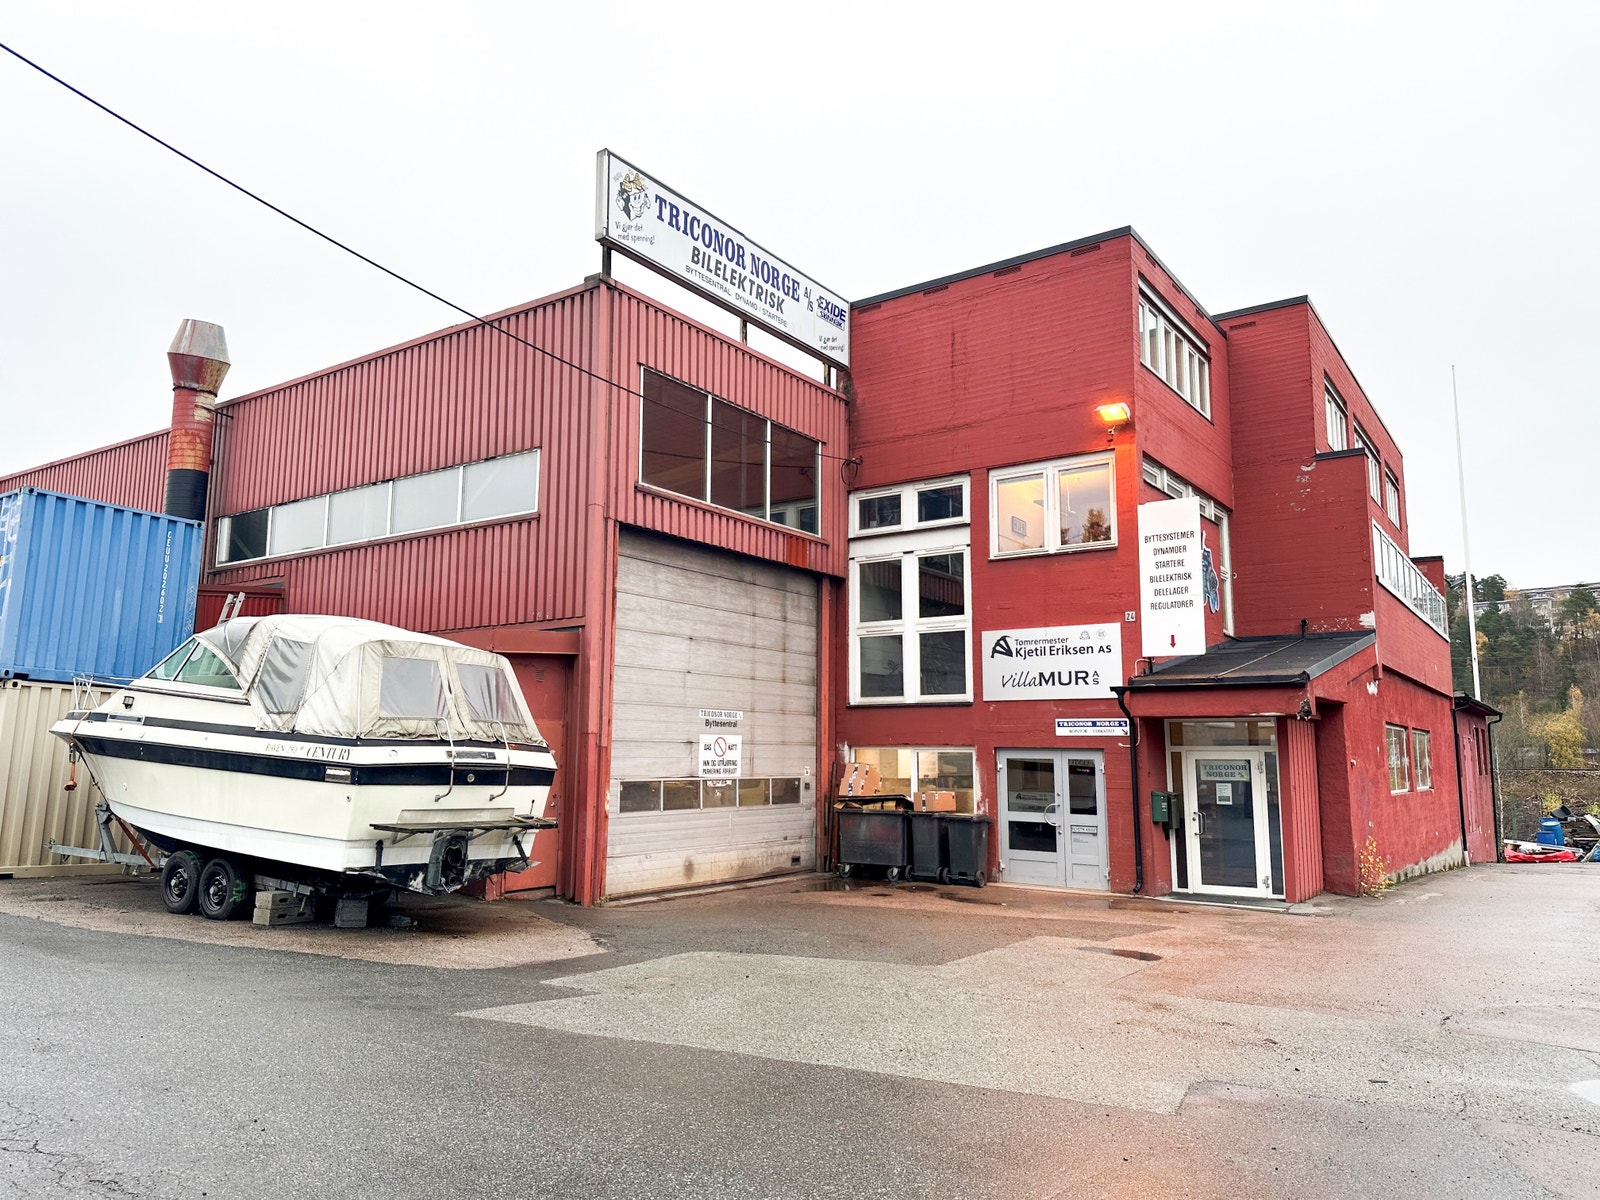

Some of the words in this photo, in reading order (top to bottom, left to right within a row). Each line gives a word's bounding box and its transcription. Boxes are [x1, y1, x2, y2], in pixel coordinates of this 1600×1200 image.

[615, 221, 621, 229] Vi
[634, 222, 643, 232] det
[617, 232, 629, 241] med
[655, 194, 746, 271] TRICONOR
[750, 252, 800, 303] NORGE
[691, 245, 785, 315] BILELEKTRISK
[735, 292, 758, 311] DYNAMO
[762, 308, 788, 328] STARTERE
[818, 295, 847, 322] EXIDE
[1144, 530, 1195, 544] BYTTESYSTEMER
[1153, 545, 1187, 556] DYNAMOER
[1155, 559, 1185, 569] STARTERE
[1149, 572, 1192, 583] BILELEKTRISK
[1154, 586, 1189, 597] DELELAGER
[1150, 599, 1194, 610] REGULATORER
[1126, 612, 1134, 620] 24
[1014, 637, 1069, 646] Tømrermester
[1015, 646, 1046, 660] Kjetil
[1049, 644, 1094, 656] Eriksen
[1097, 644, 1112, 654] AS
[1001, 670, 1090, 688] VillaMUR
[700, 710, 723, 718] TRICONOR
[724, 711, 738, 719] NORGE
[705, 719, 738, 728] Byttesentral
[306, 746, 353, 761] CENTURY
